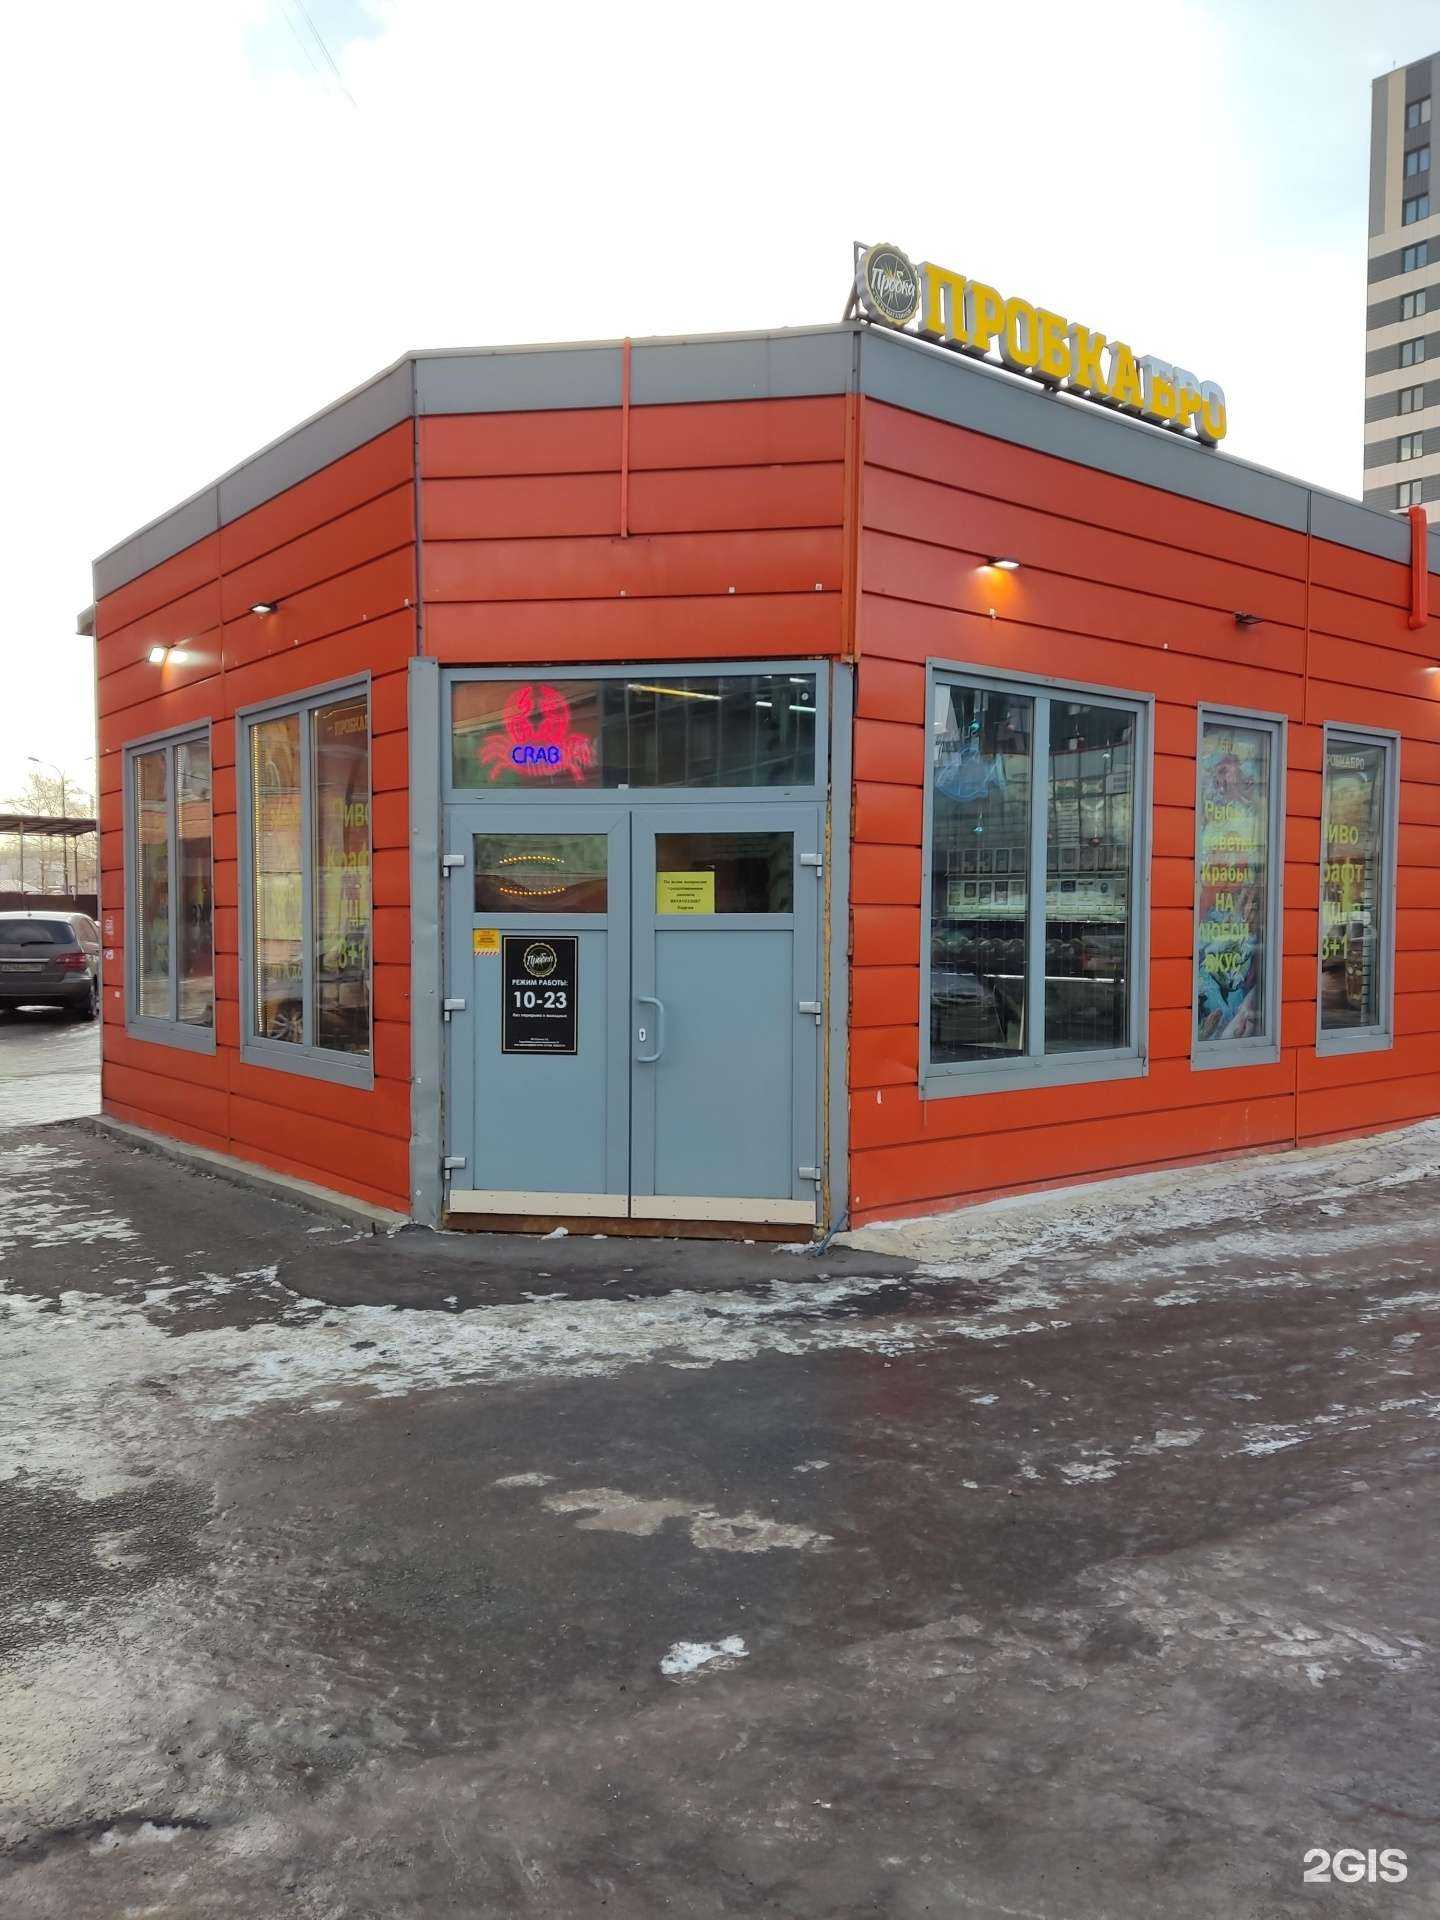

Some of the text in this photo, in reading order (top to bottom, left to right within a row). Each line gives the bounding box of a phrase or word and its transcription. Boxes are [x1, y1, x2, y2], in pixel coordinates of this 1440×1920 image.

[512, 746, 560, 764] CRAB
[1327, 824, 1359, 845] ИВО
[1215, 892, 1233, 913] НА
[511, 979, 569, 987] РЕЖИМ РАБОТЫ:
[513, 991, 567, 1009] 10-23
